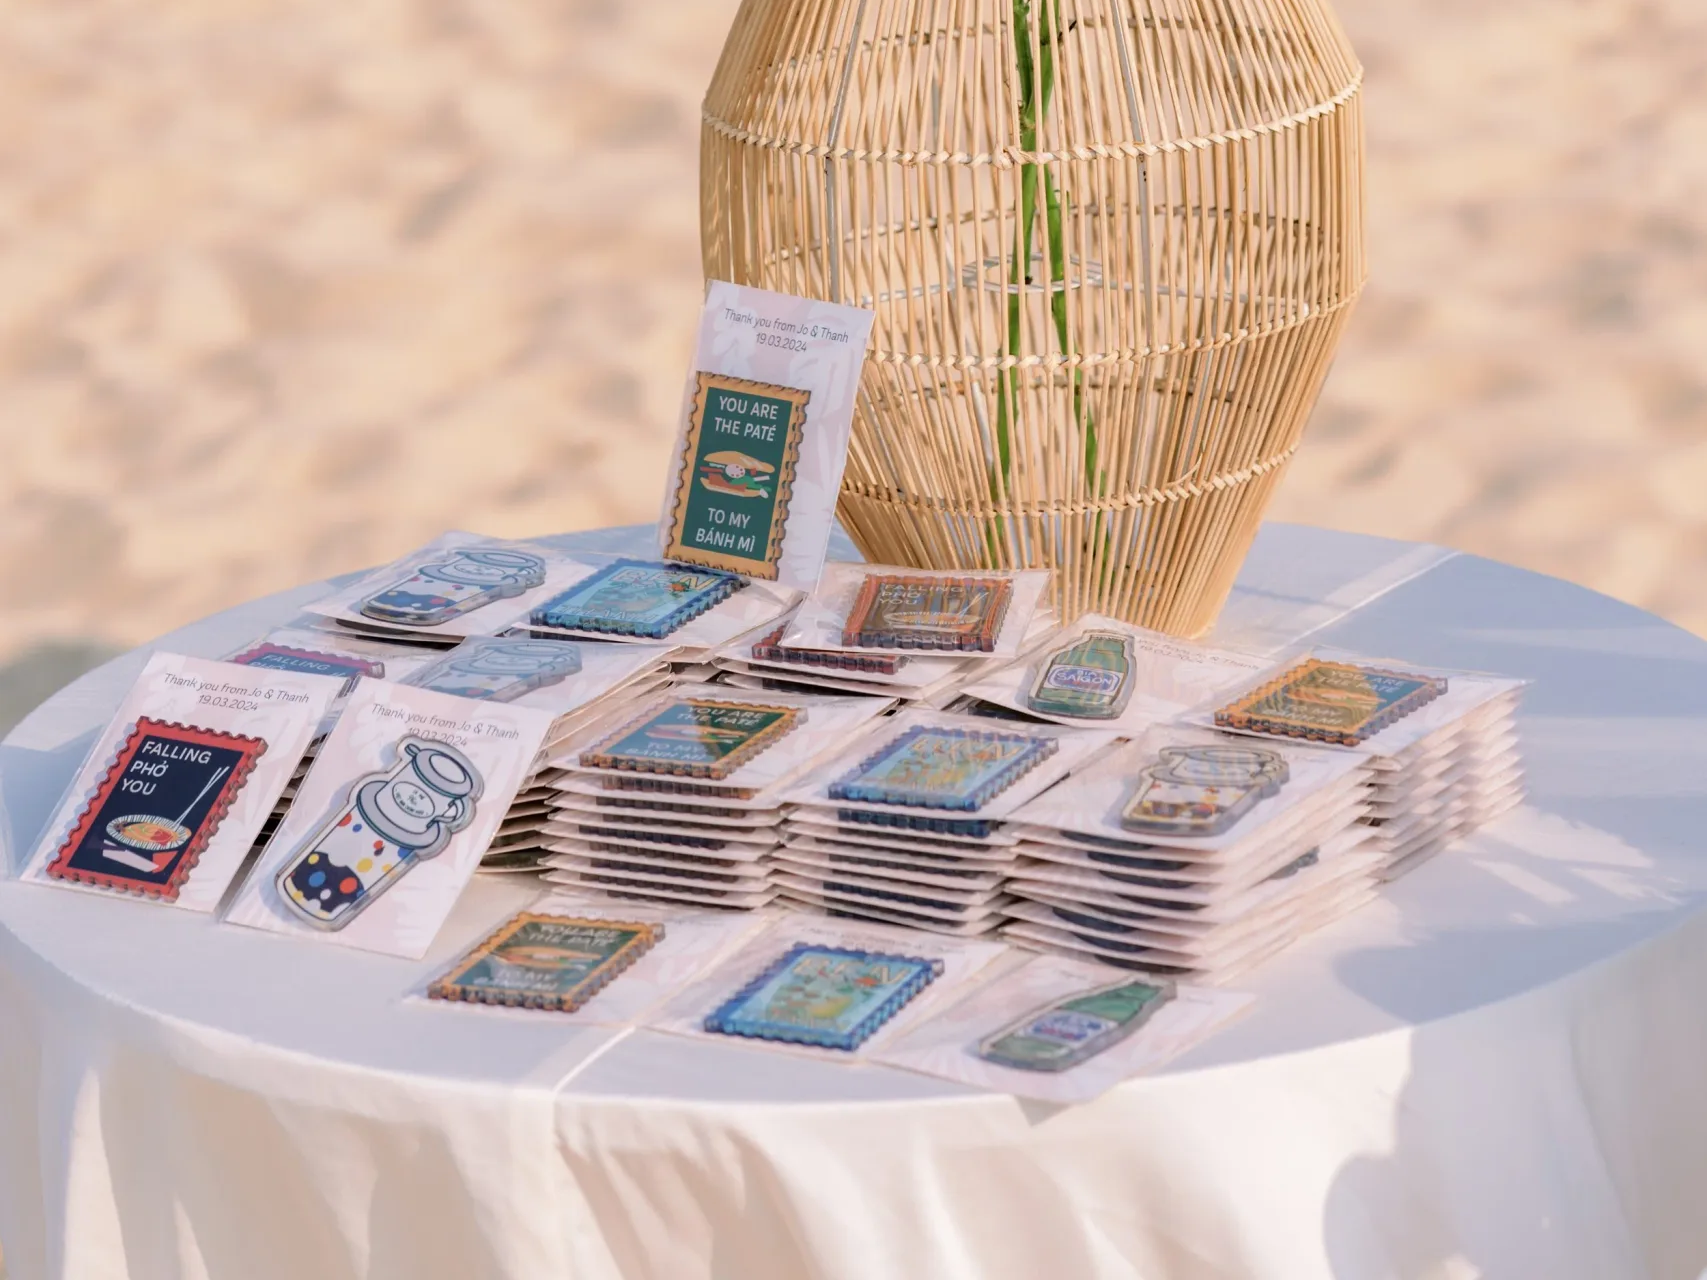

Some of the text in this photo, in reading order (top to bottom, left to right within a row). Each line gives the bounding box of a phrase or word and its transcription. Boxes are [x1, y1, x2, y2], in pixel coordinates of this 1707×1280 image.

[724, 307, 849, 343] Thank you from Jo & Thanh
[756, 332, 808, 353] 19.03.2024
[719, 395, 779, 420] YOU ARE
[714, 417, 777, 442] THE PATÉ
[707, 507, 751, 529] TO MY
[695, 527, 756, 553] BÁNH MÌ
[261, 654, 330, 671] FALLING
[164, 672, 310, 704] Thank you from Jo & Thanh
[197, 694, 259, 712] 19.03.2024
[371, 702, 520, 740] Thank you from Jo & Thanh
[141, 740, 212, 764] FALLING
[129, 760, 169, 778] PHỞ
[121, 777, 157, 796] YOU
